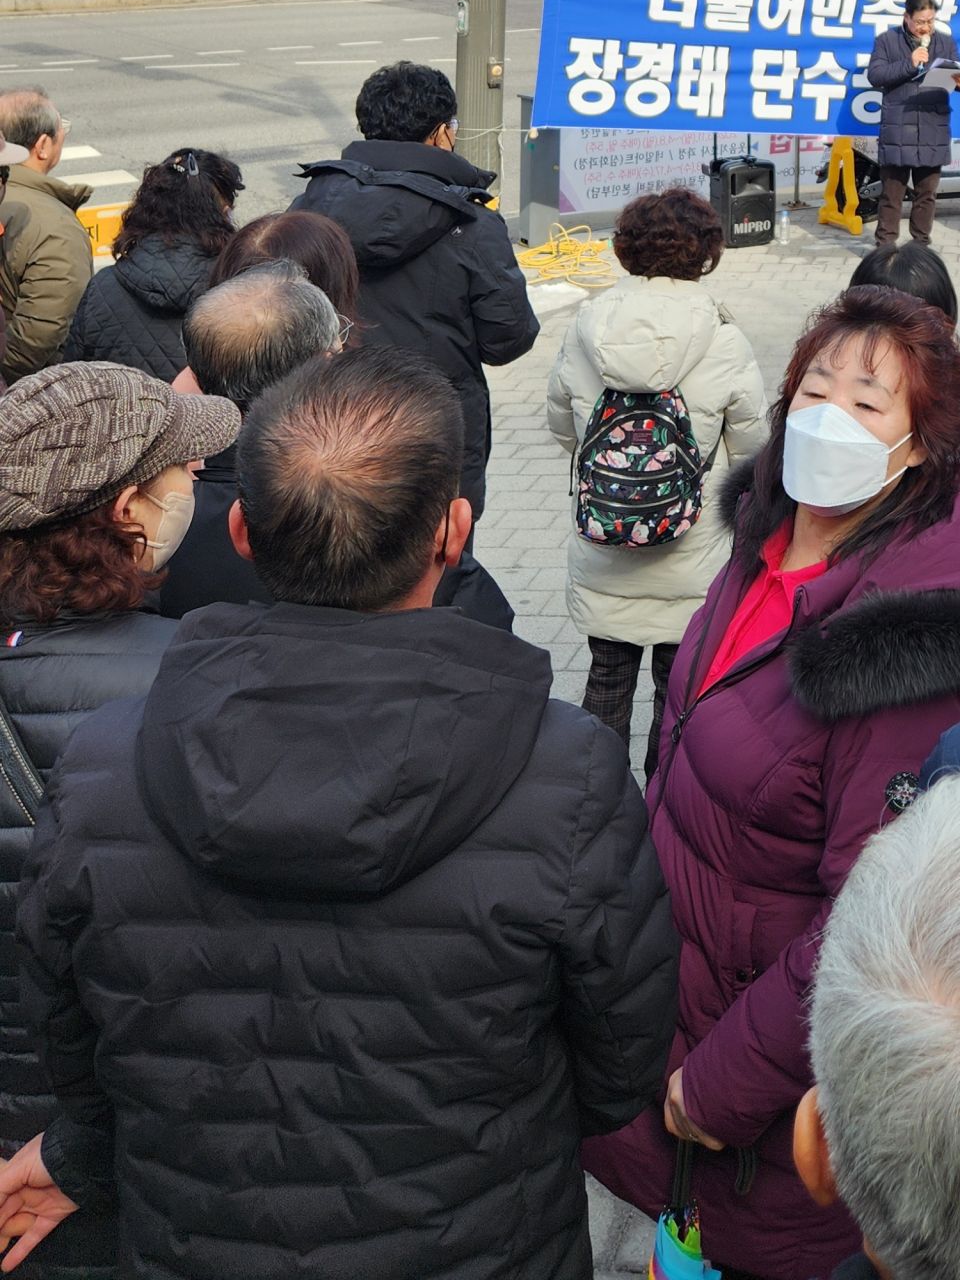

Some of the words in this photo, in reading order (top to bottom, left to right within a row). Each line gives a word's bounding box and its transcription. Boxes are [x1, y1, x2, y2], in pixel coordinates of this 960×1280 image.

[564, 36, 731, 118] 장경태
[750, 47, 884, 125] 단수공
[734, 220, 771, 234] MIPRO
